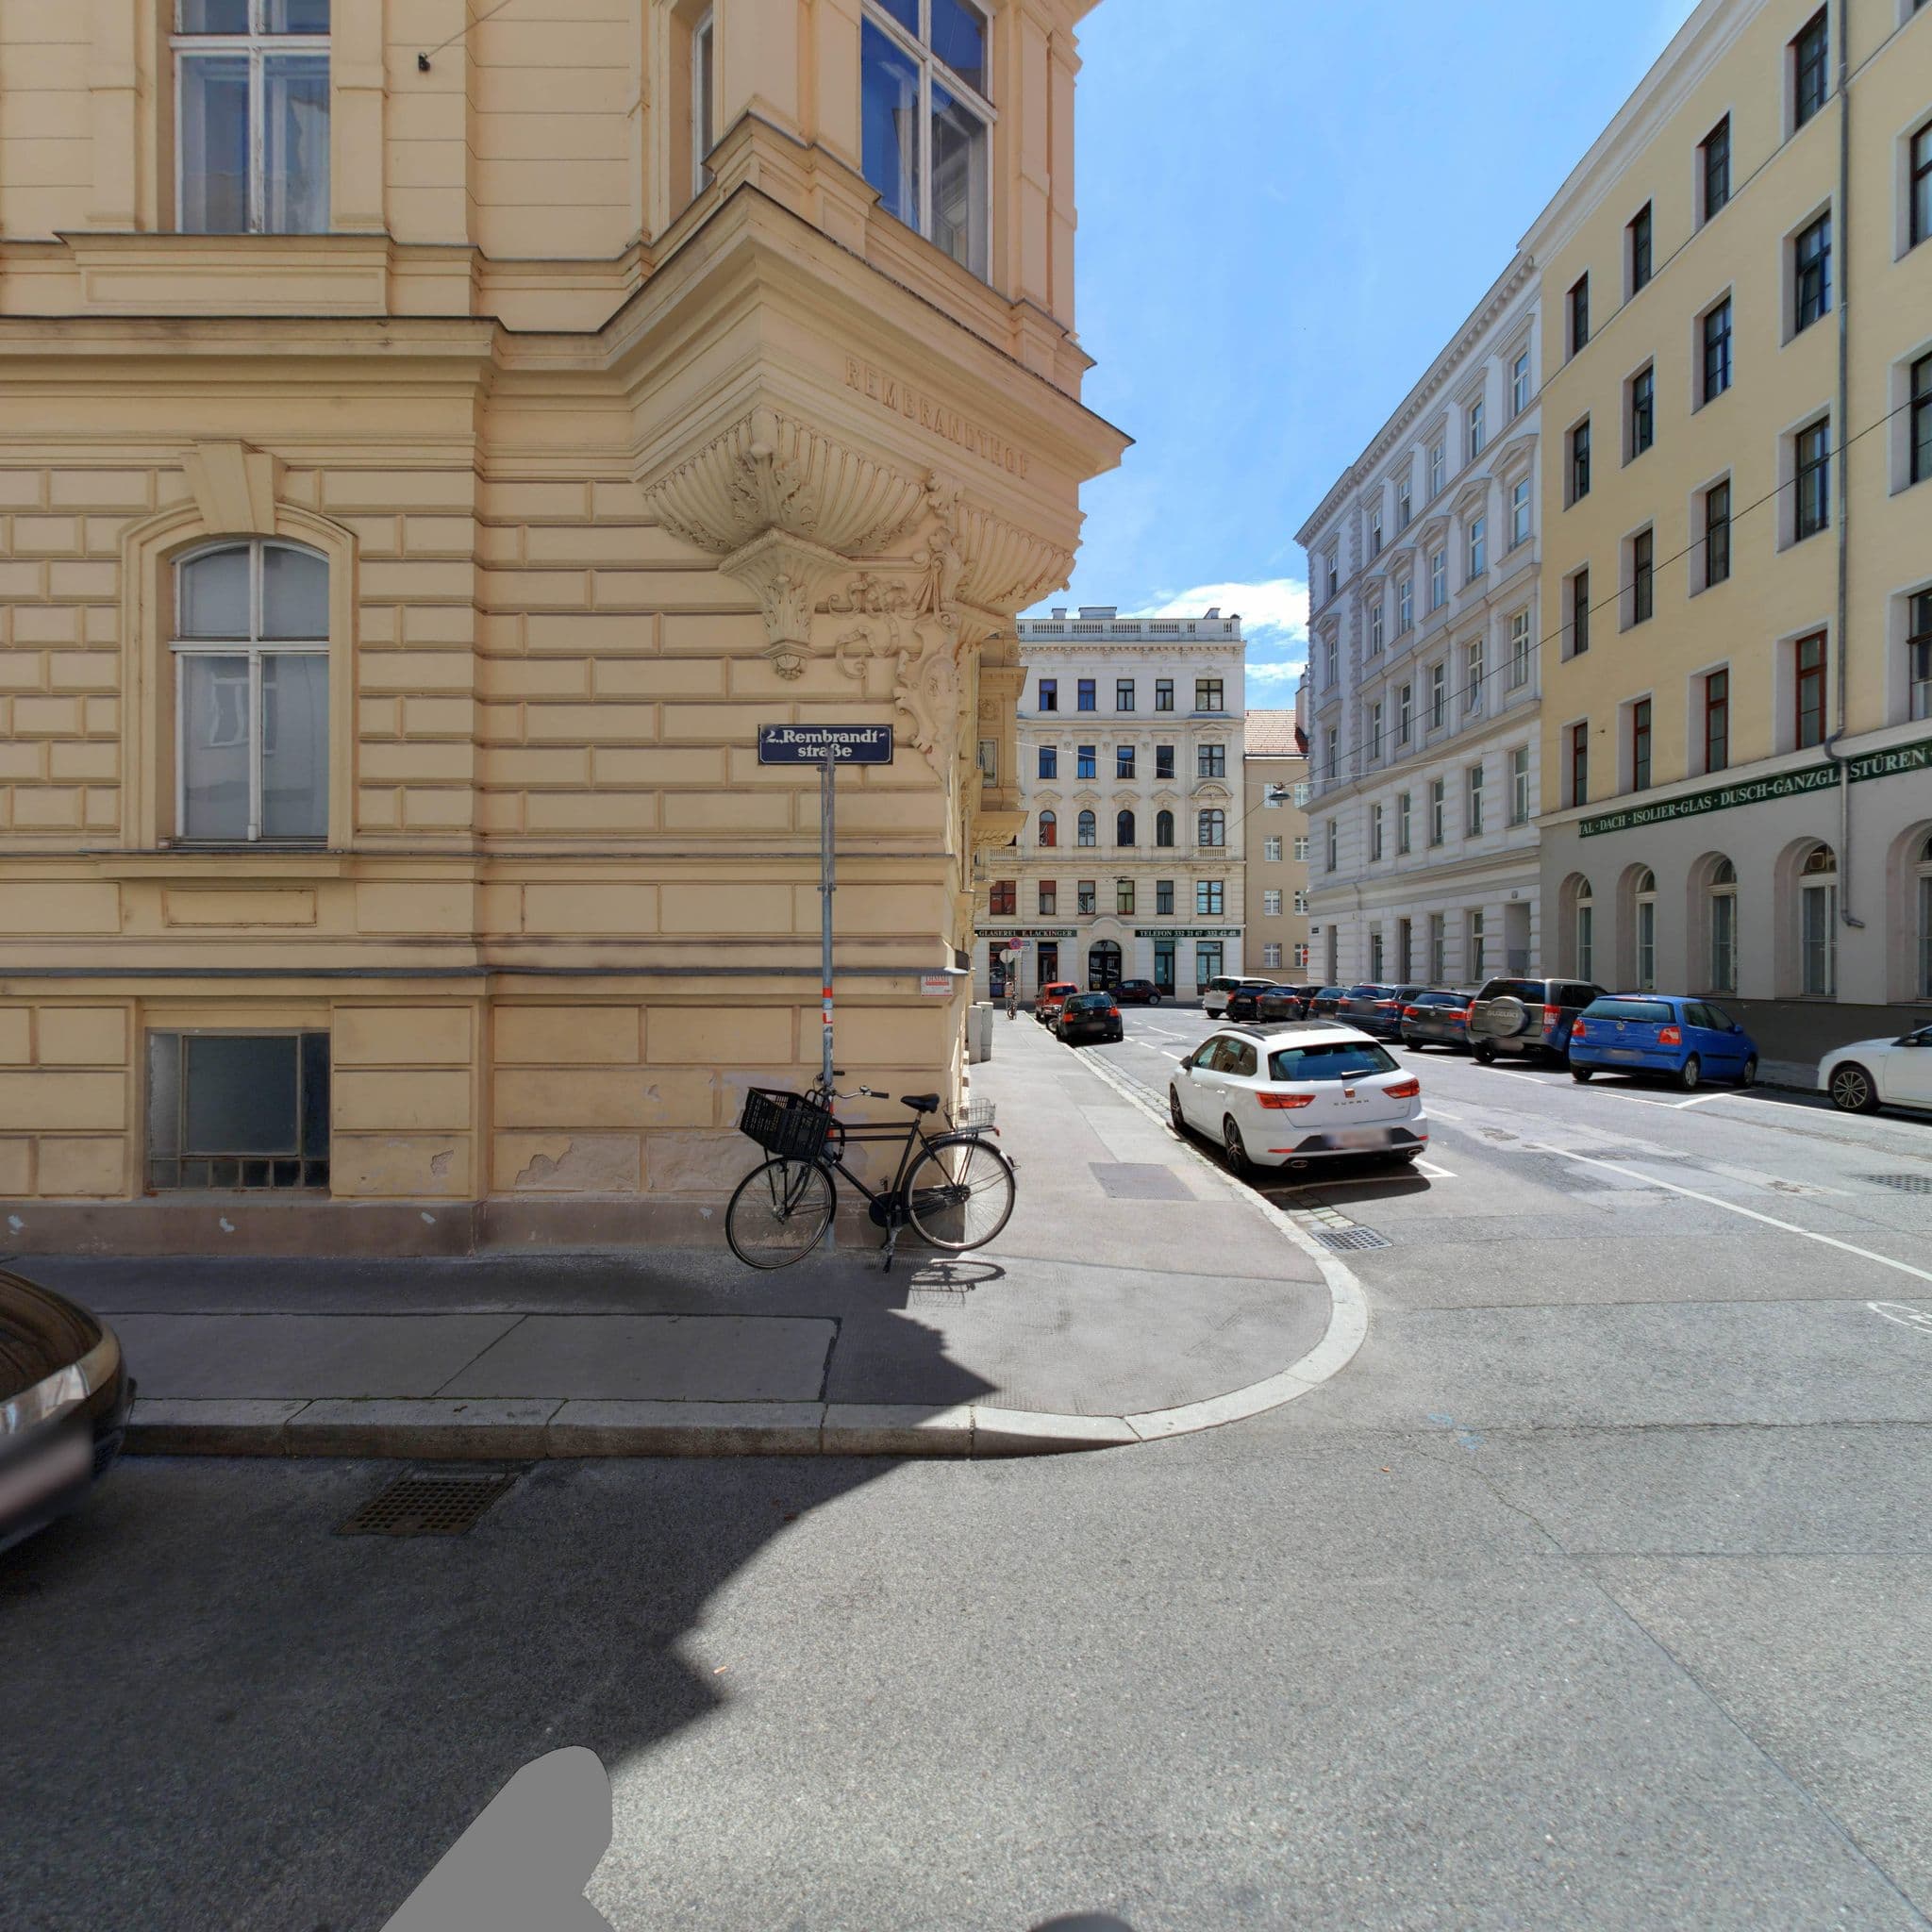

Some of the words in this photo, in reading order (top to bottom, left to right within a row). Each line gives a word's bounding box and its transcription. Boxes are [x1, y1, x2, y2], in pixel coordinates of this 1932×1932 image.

[845, 357, 1029, 479] REMBRANDTHOF
[798, 743, 853, 757] straße
[1600, 815, 1625, 830] DACH
[1633, 795, 1712, 824] ISOLIER-GLAS
